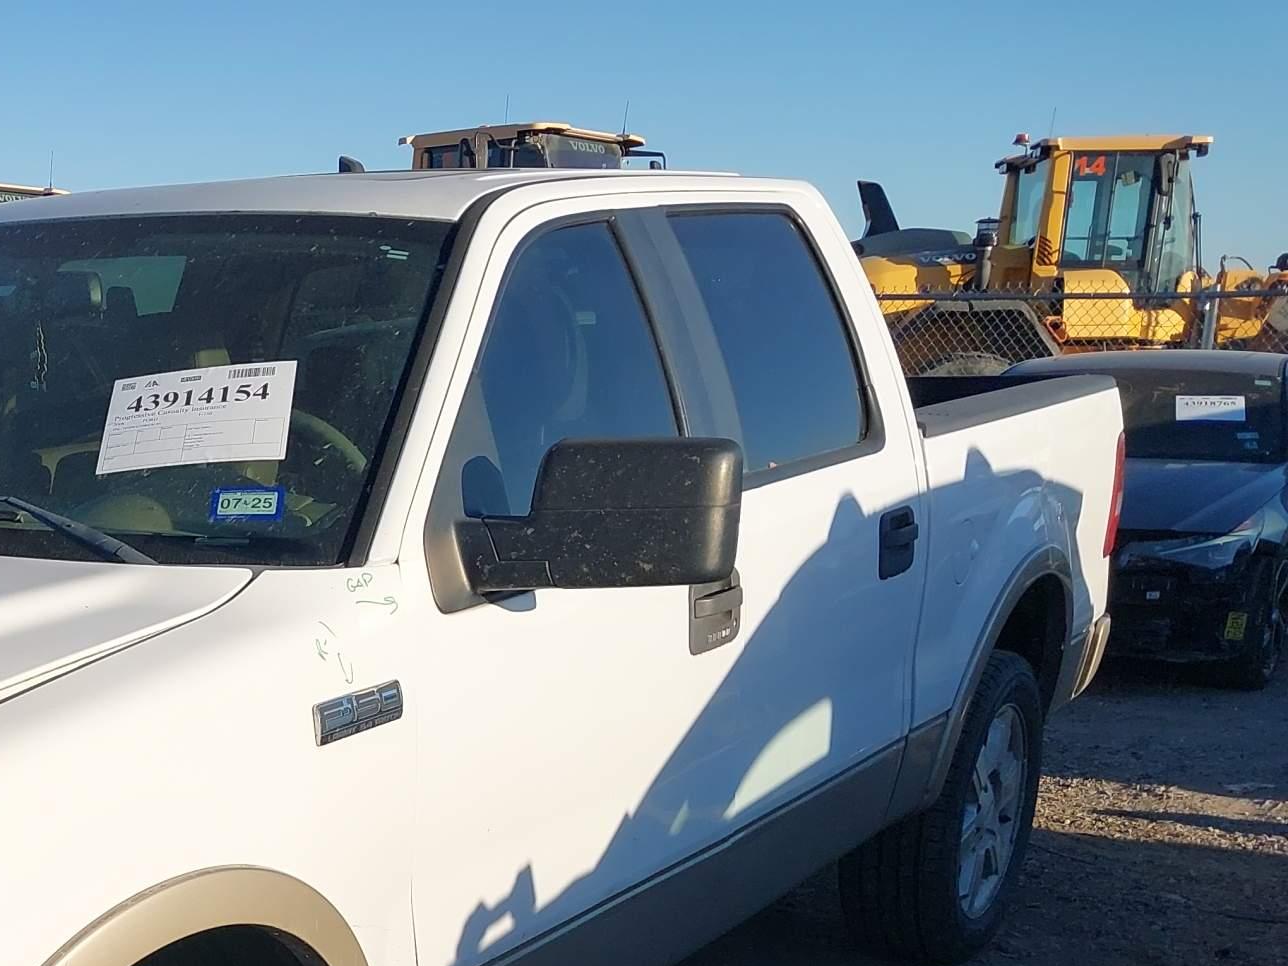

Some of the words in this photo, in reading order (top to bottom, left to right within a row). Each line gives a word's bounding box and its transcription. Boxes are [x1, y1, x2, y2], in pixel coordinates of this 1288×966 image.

[568, 141, 605, 154] VOLVO
[1076, 156, 1106, 176] 14
[920, 252, 977, 263] VOLVO
[126, 382, 270, 412] 43914154
[114, 410, 155, 423] Progressive
[158, 407, 188, 417] Casualty
[191, 404, 227, 413] Insurance
[220, 498, 242, 510] 07
[251, 497, 273, 509] 25
[346, 572, 373, 592] GAP
